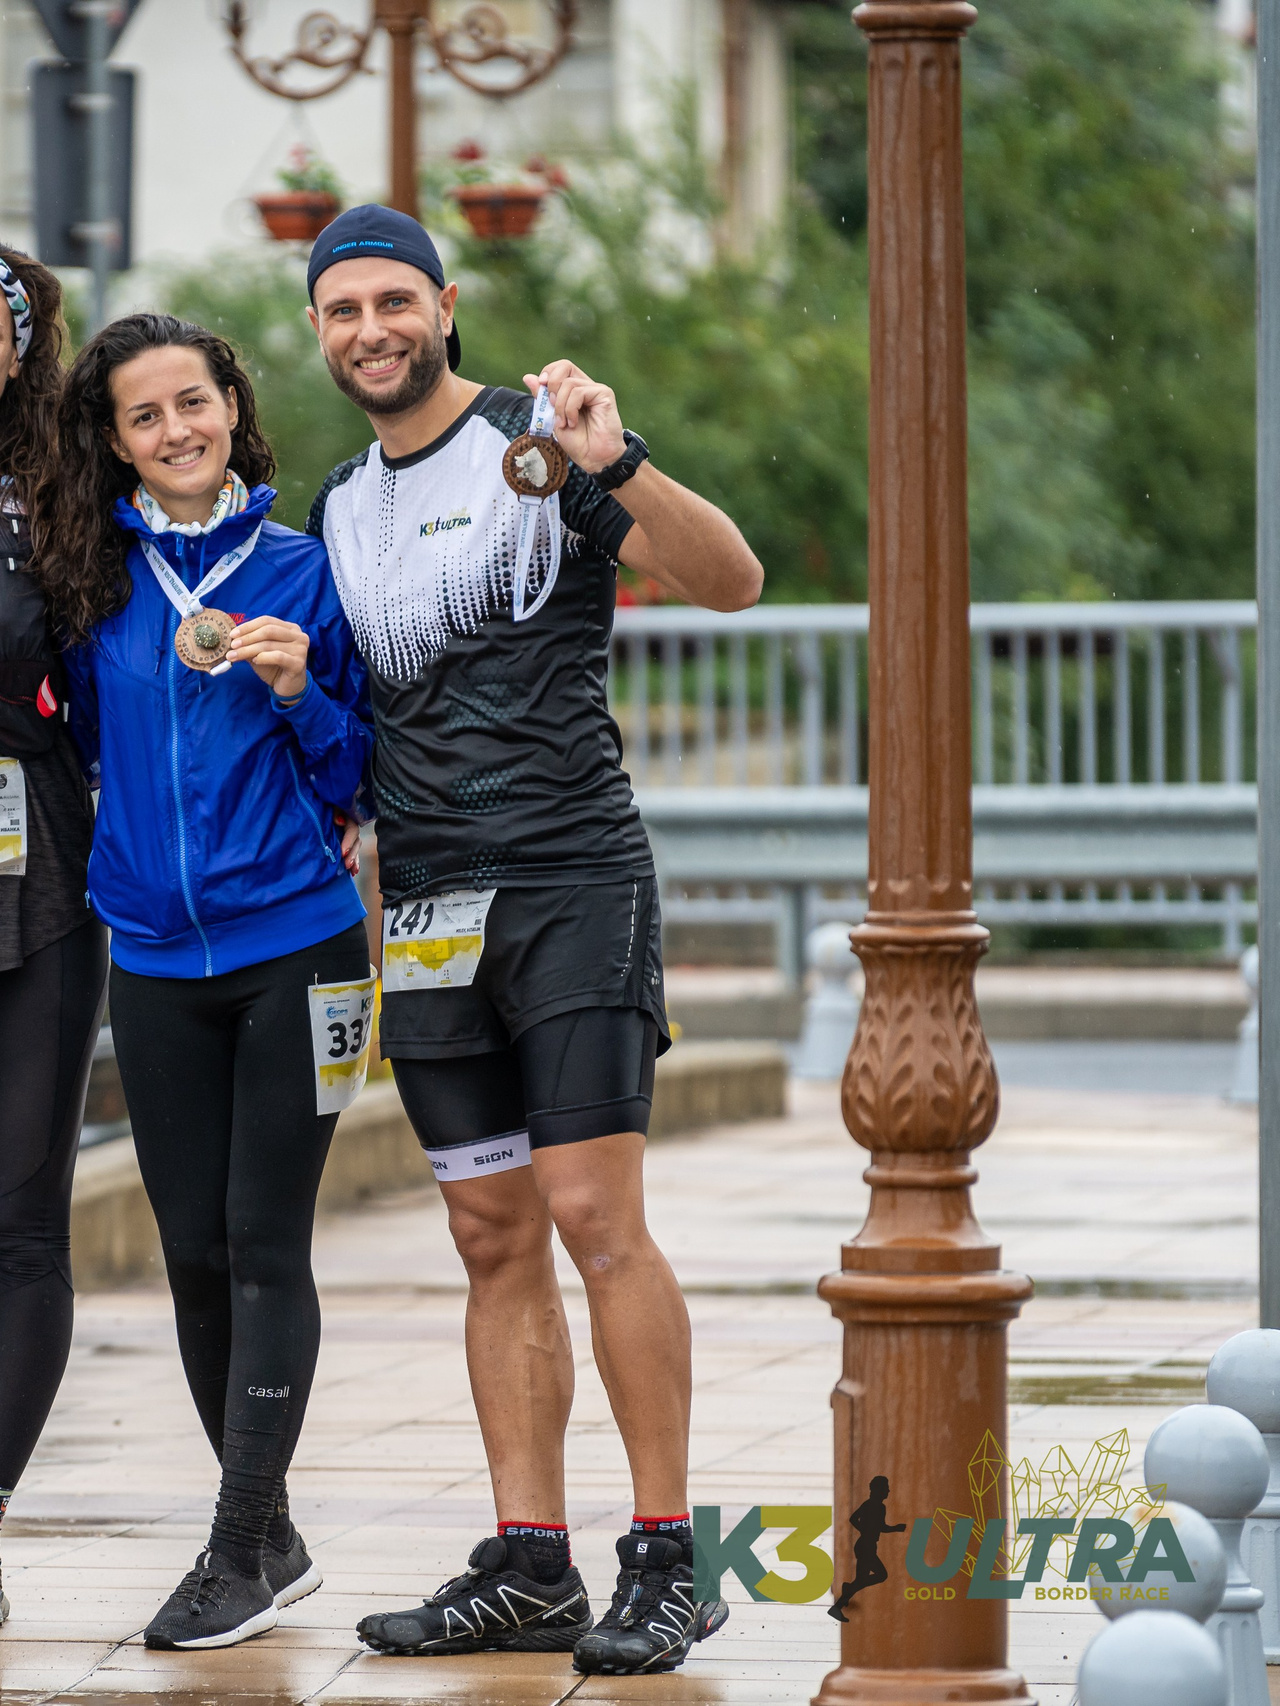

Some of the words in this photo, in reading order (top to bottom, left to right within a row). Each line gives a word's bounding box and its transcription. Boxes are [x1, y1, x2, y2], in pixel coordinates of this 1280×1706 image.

[332, 241, 357, 253] UNDER
[358, 240, 394, 249] ARMOUR
[419, 521, 435, 537] K3
[440, 516, 472, 530] ULTRA
[190, 616, 214, 626] ULTRA
[217, 621, 228, 640] RACE
[389, 902, 435, 937] 241
[247, 1385, 290, 1398] casall
